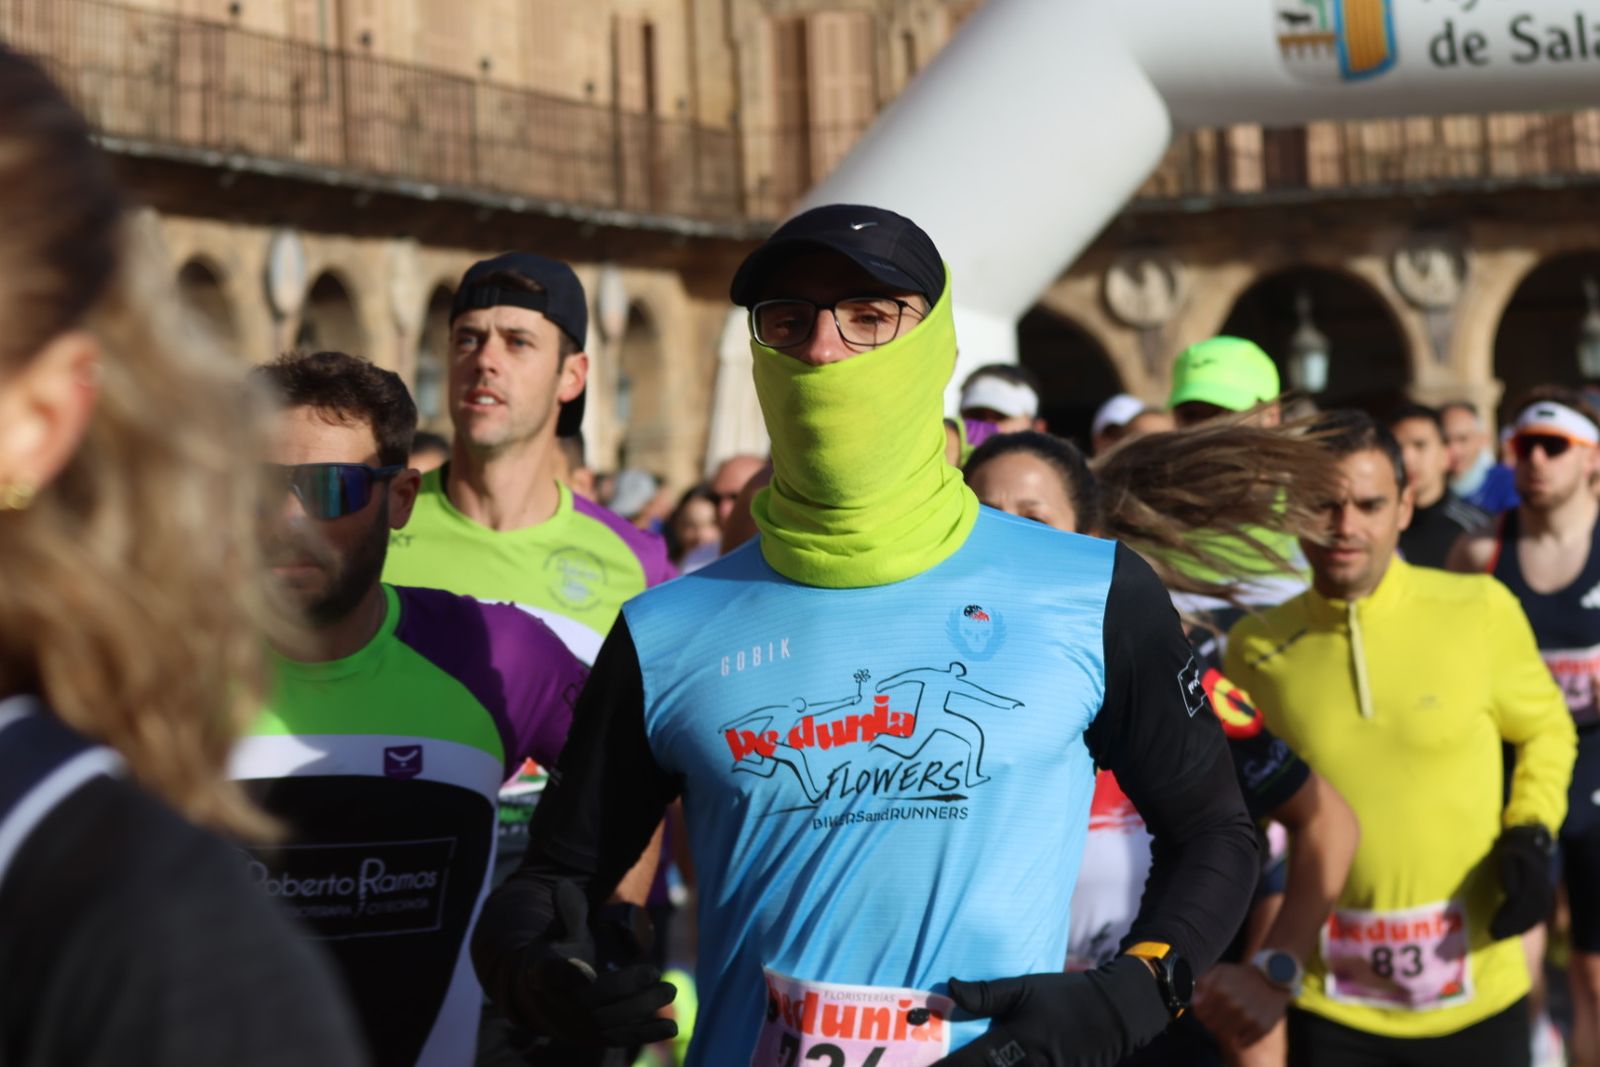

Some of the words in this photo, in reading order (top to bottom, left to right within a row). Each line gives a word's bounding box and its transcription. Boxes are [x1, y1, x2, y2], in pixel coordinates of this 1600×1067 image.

[1429, 19, 1489, 67] de
[720, 637, 791, 677] GOBIK
[823, 760, 965, 799] FLOWERS
[812, 805, 970, 831] BIKERSandRUNNERS
[359, 857, 438, 908] Ramos
[1371, 943, 1424, 978] 83
